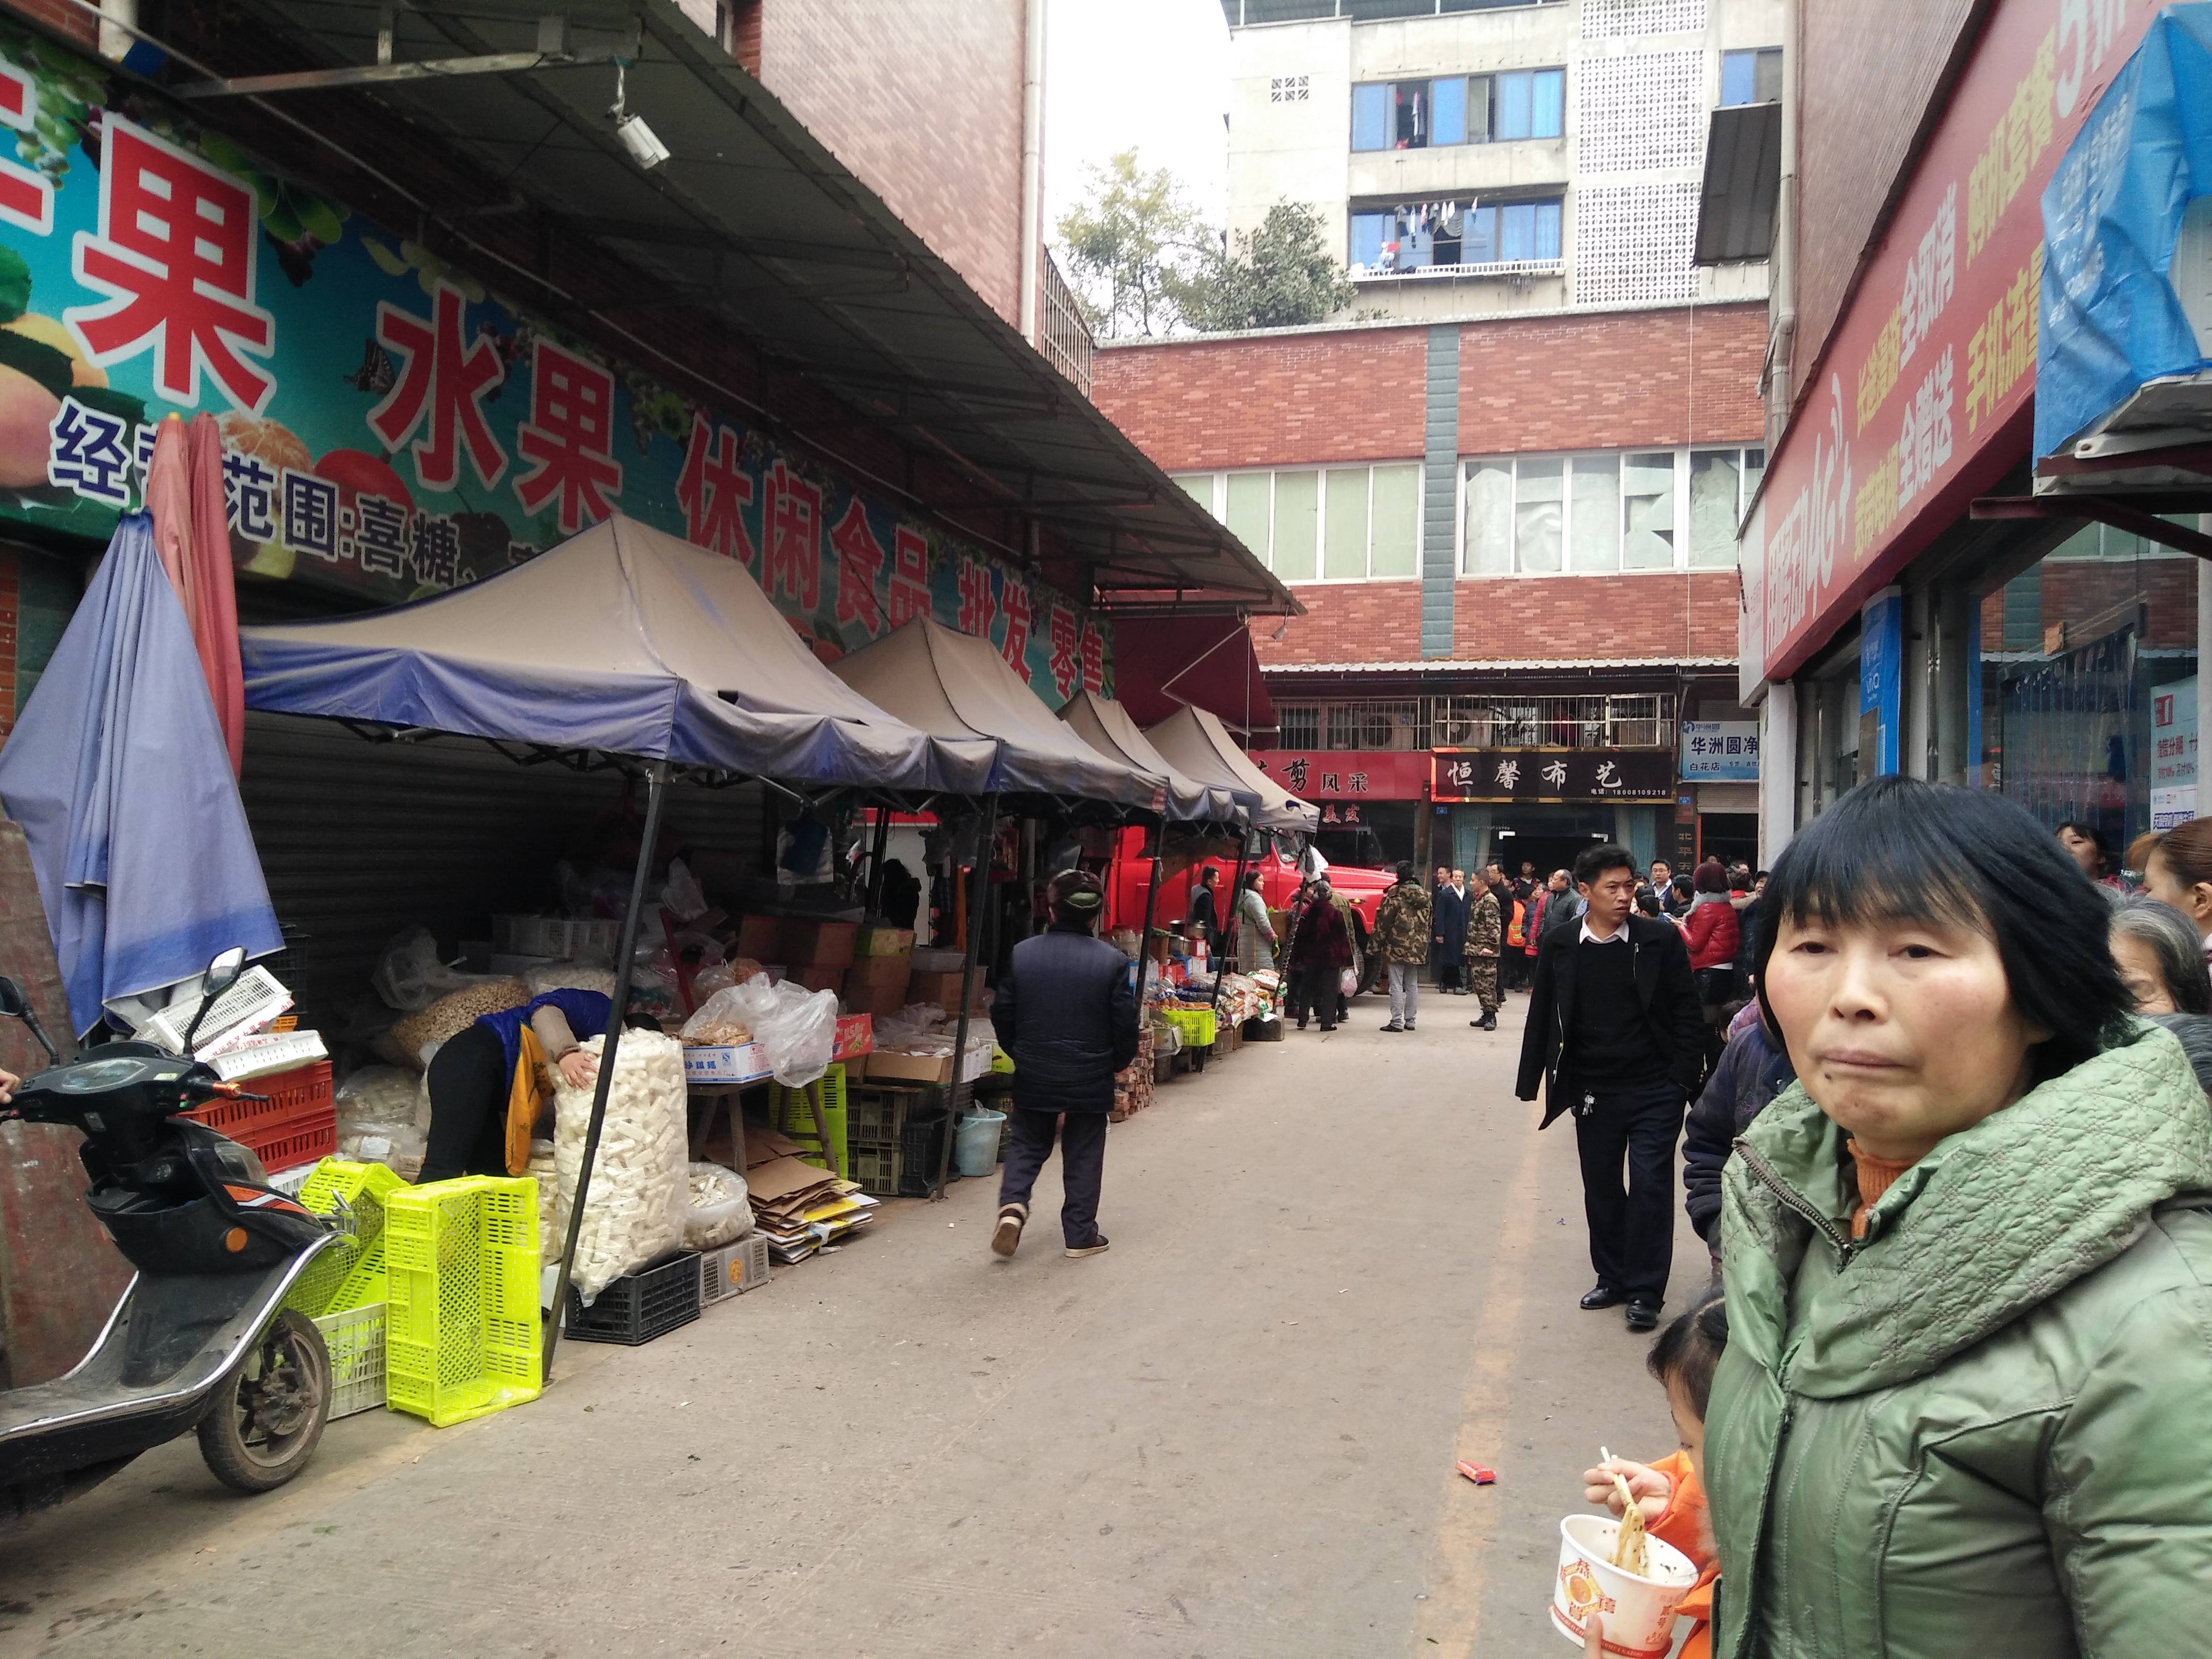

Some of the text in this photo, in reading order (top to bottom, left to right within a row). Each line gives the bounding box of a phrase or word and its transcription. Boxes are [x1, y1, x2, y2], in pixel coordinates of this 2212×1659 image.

[367, 278, 623, 532] 水果
[676, 412, 932, 634] 休闲食品
[959, 558, 1032, 685] 批发
[1049, 601, 1103, 700] 零售
[1691, 736, 1758, 755] 华洲圆净
[1447, 758, 1622, 791] 恒馨布艺
[1689, 762, 1720, 771] 白花店
[1322, 803, 1360, 824] 美发
